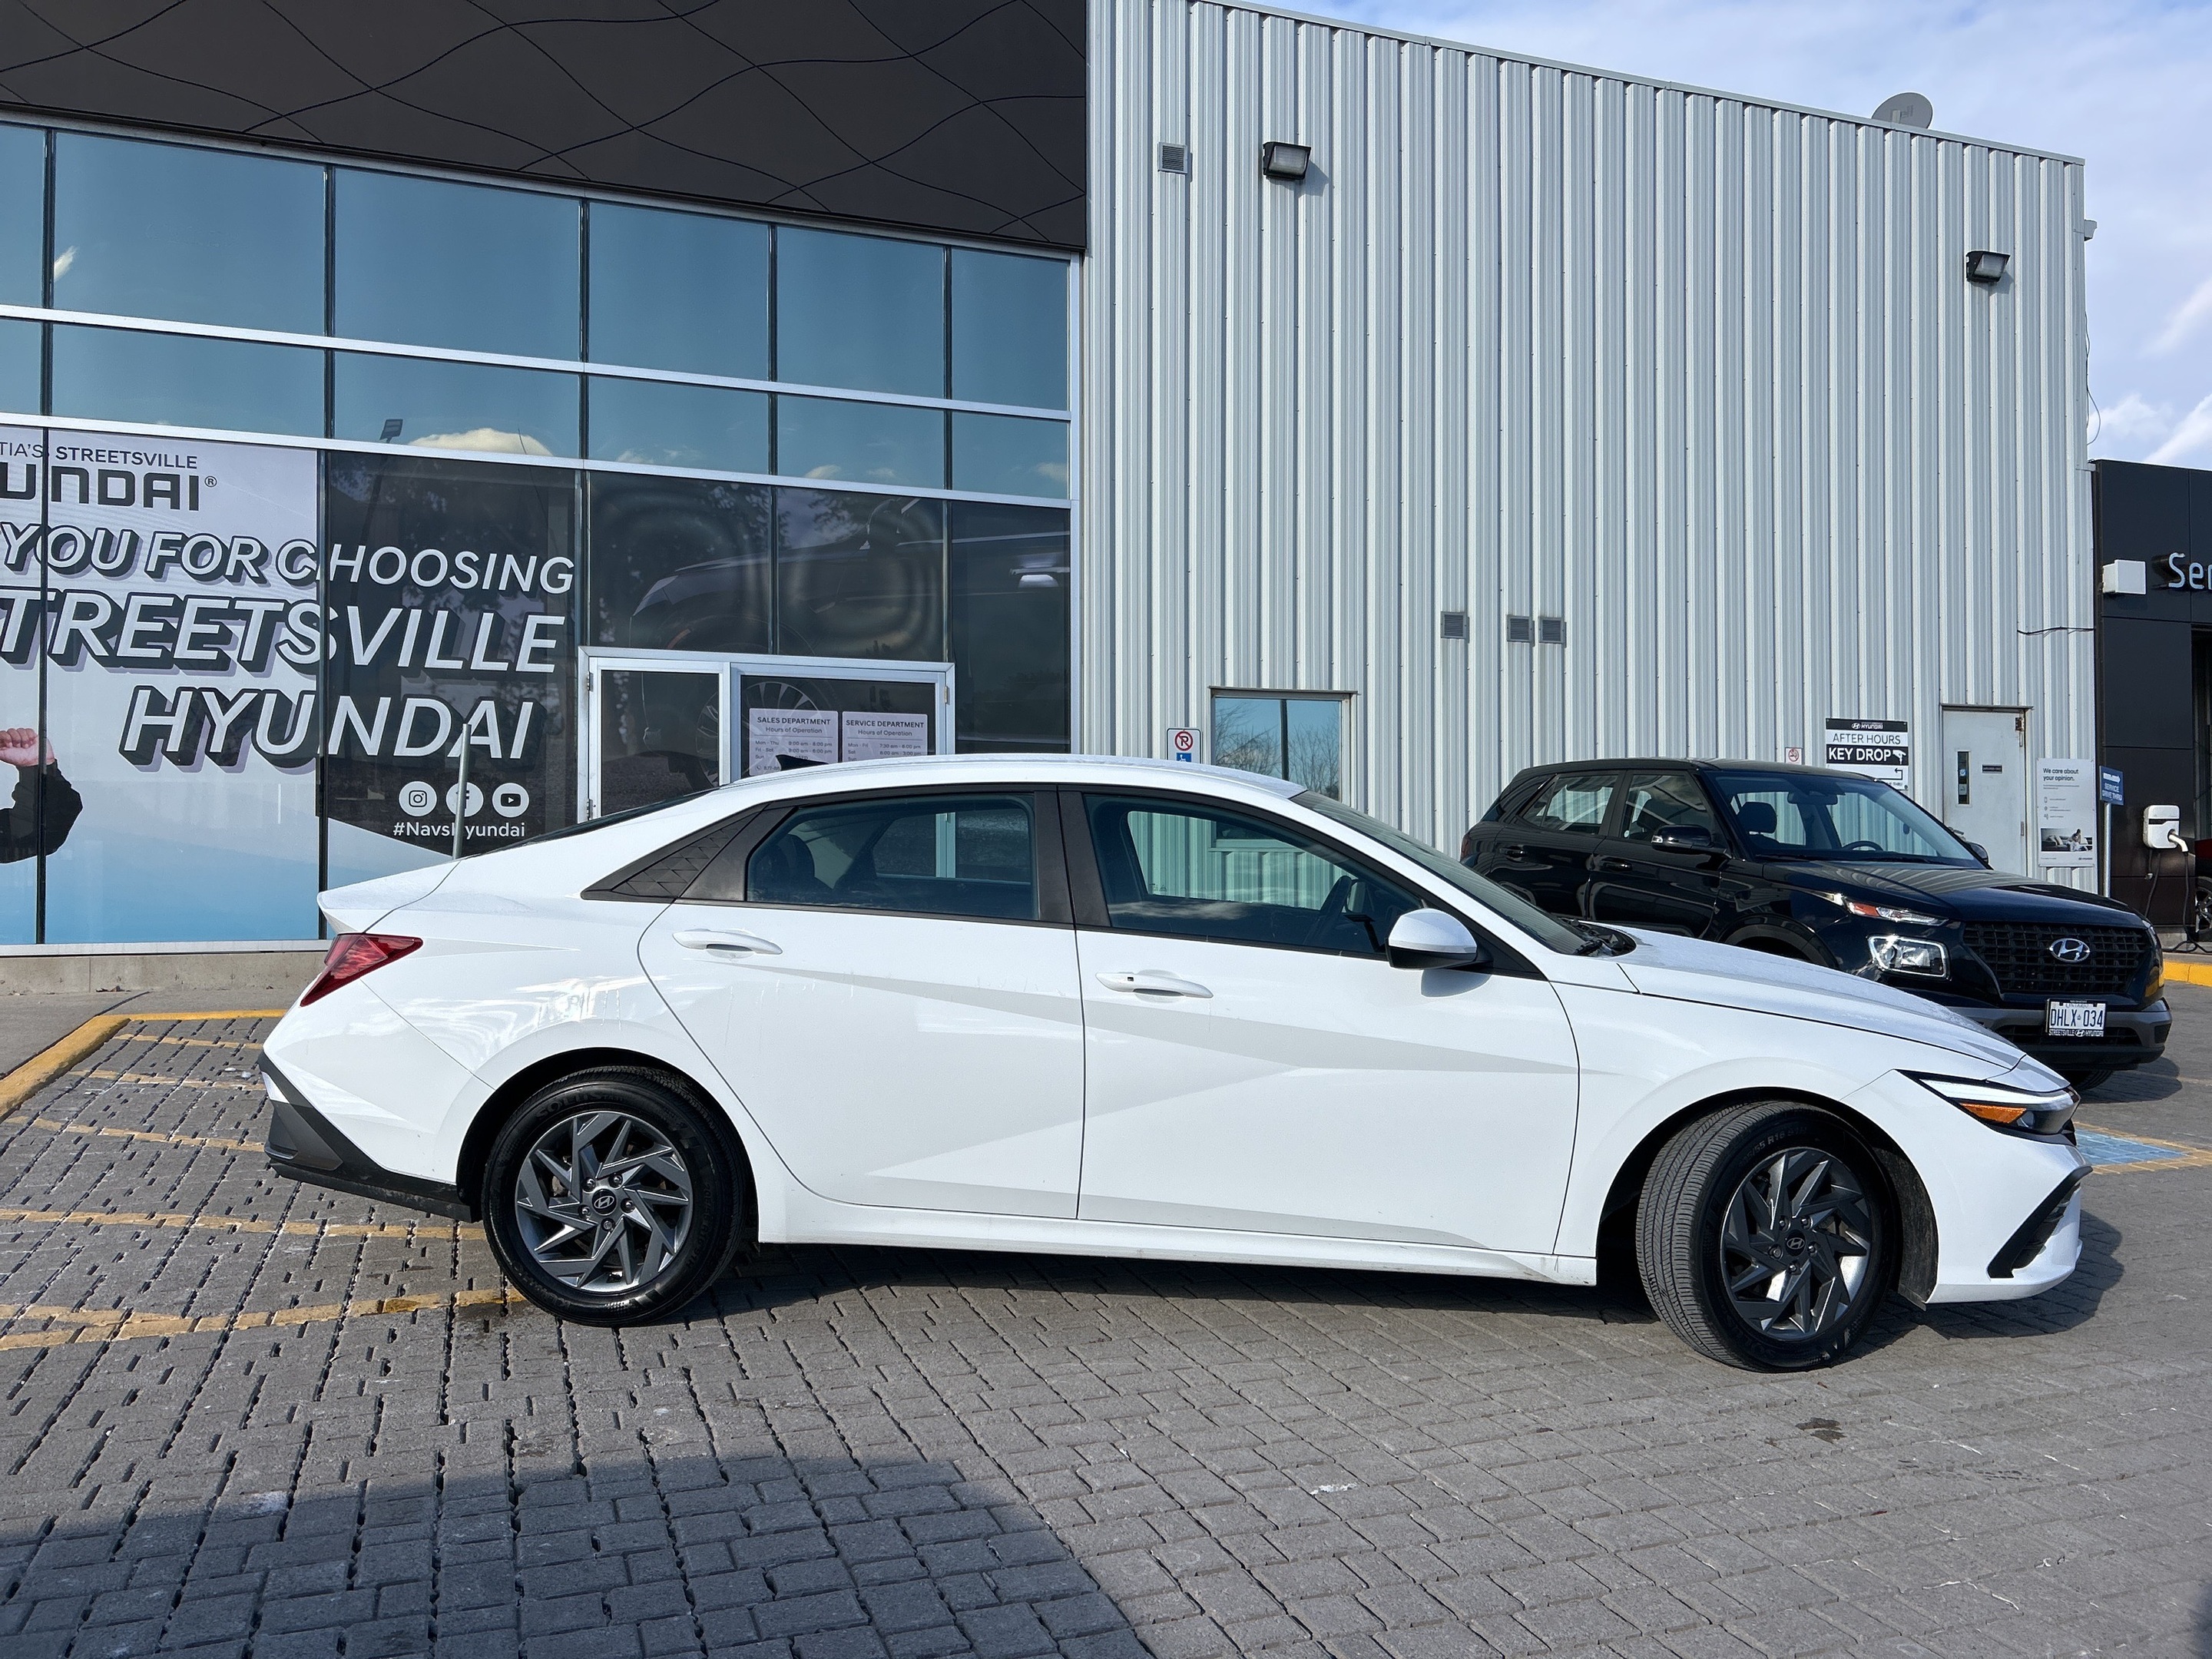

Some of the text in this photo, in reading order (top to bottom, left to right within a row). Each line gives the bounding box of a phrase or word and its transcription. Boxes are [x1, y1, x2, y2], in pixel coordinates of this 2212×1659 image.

[55, 445, 198, 469] STREETSVILLE
[1, 522, 575, 594] YOU FOR CHOOSING
[0, 590, 565, 674] TREETSVILLE
[122, 688, 535, 760] HYUNDAI
[1833, 733, 1901, 745] AFTER HOURS
[1829, 747, 1891, 762] KEY DROP
[2050, 1008, 2104, 1028] DHLX 034
